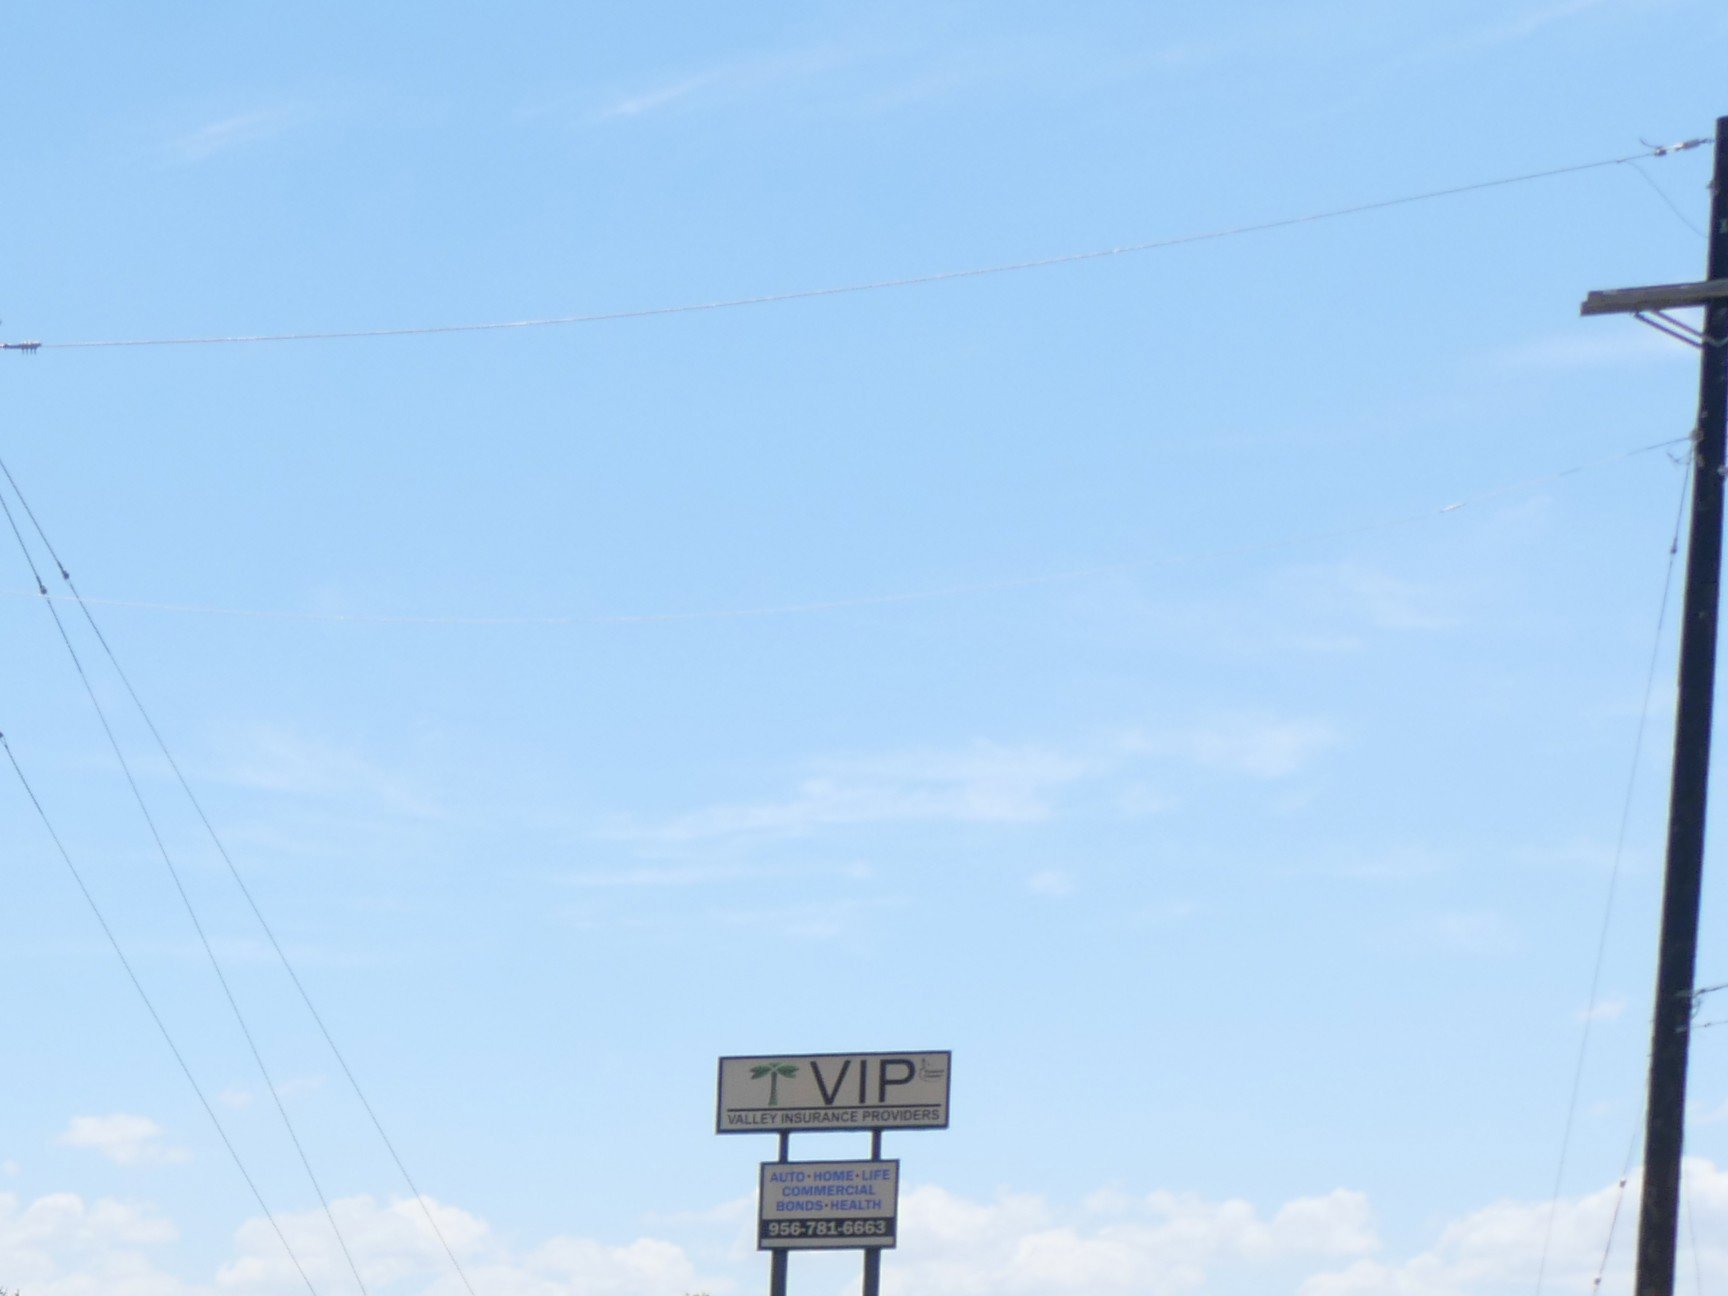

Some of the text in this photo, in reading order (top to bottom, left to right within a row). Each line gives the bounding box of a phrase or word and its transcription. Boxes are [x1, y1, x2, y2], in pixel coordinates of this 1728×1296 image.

[810, 1059, 916, 1105] VIP
[727, 1109, 940, 1125] VALLEY INSURANCE PROVIDERS
[770, 1169, 891, 1182] AUTO HOME LIFE
[782, 1184, 876, 1197] COMMERCIAL
[776, 1199, 882, 1212] BONDS HEALTH
[768, 1221, 886, 1236] 956-781-6663
